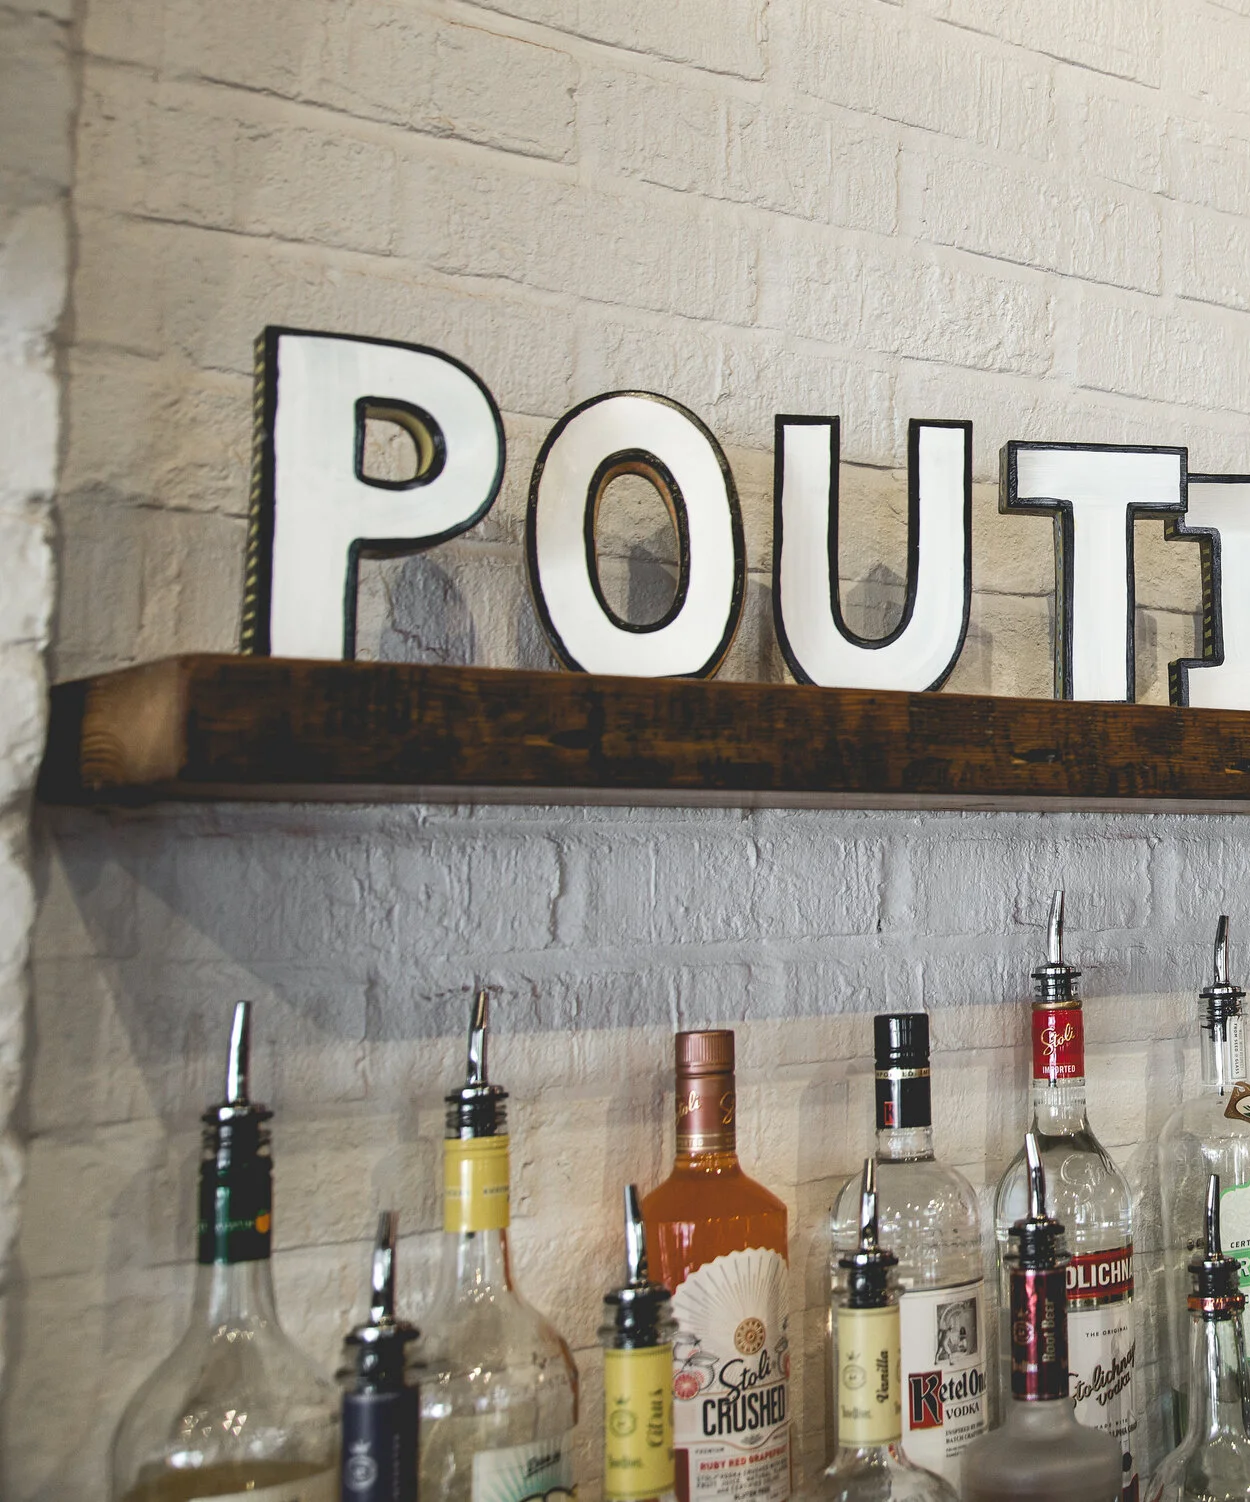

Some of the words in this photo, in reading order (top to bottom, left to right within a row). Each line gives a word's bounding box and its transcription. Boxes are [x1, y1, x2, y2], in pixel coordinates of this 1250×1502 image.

[1041, 1022, 1076, 1056] Stoli
[1042, 1064, 1076, 1074] IMPORTED
[719, 1349, 772, 1406] Stoli
[876, 1350, 889, 1404] Vanilla
[910, 1371, 968, 1425] Ketel
[703, 1384, 786, 1436] CRUSHED
[945, 1402, 981, 1420] VODKA
[699, 1459, 726, 1471] RUBY
[728, 1456, 747, 1467] RED
